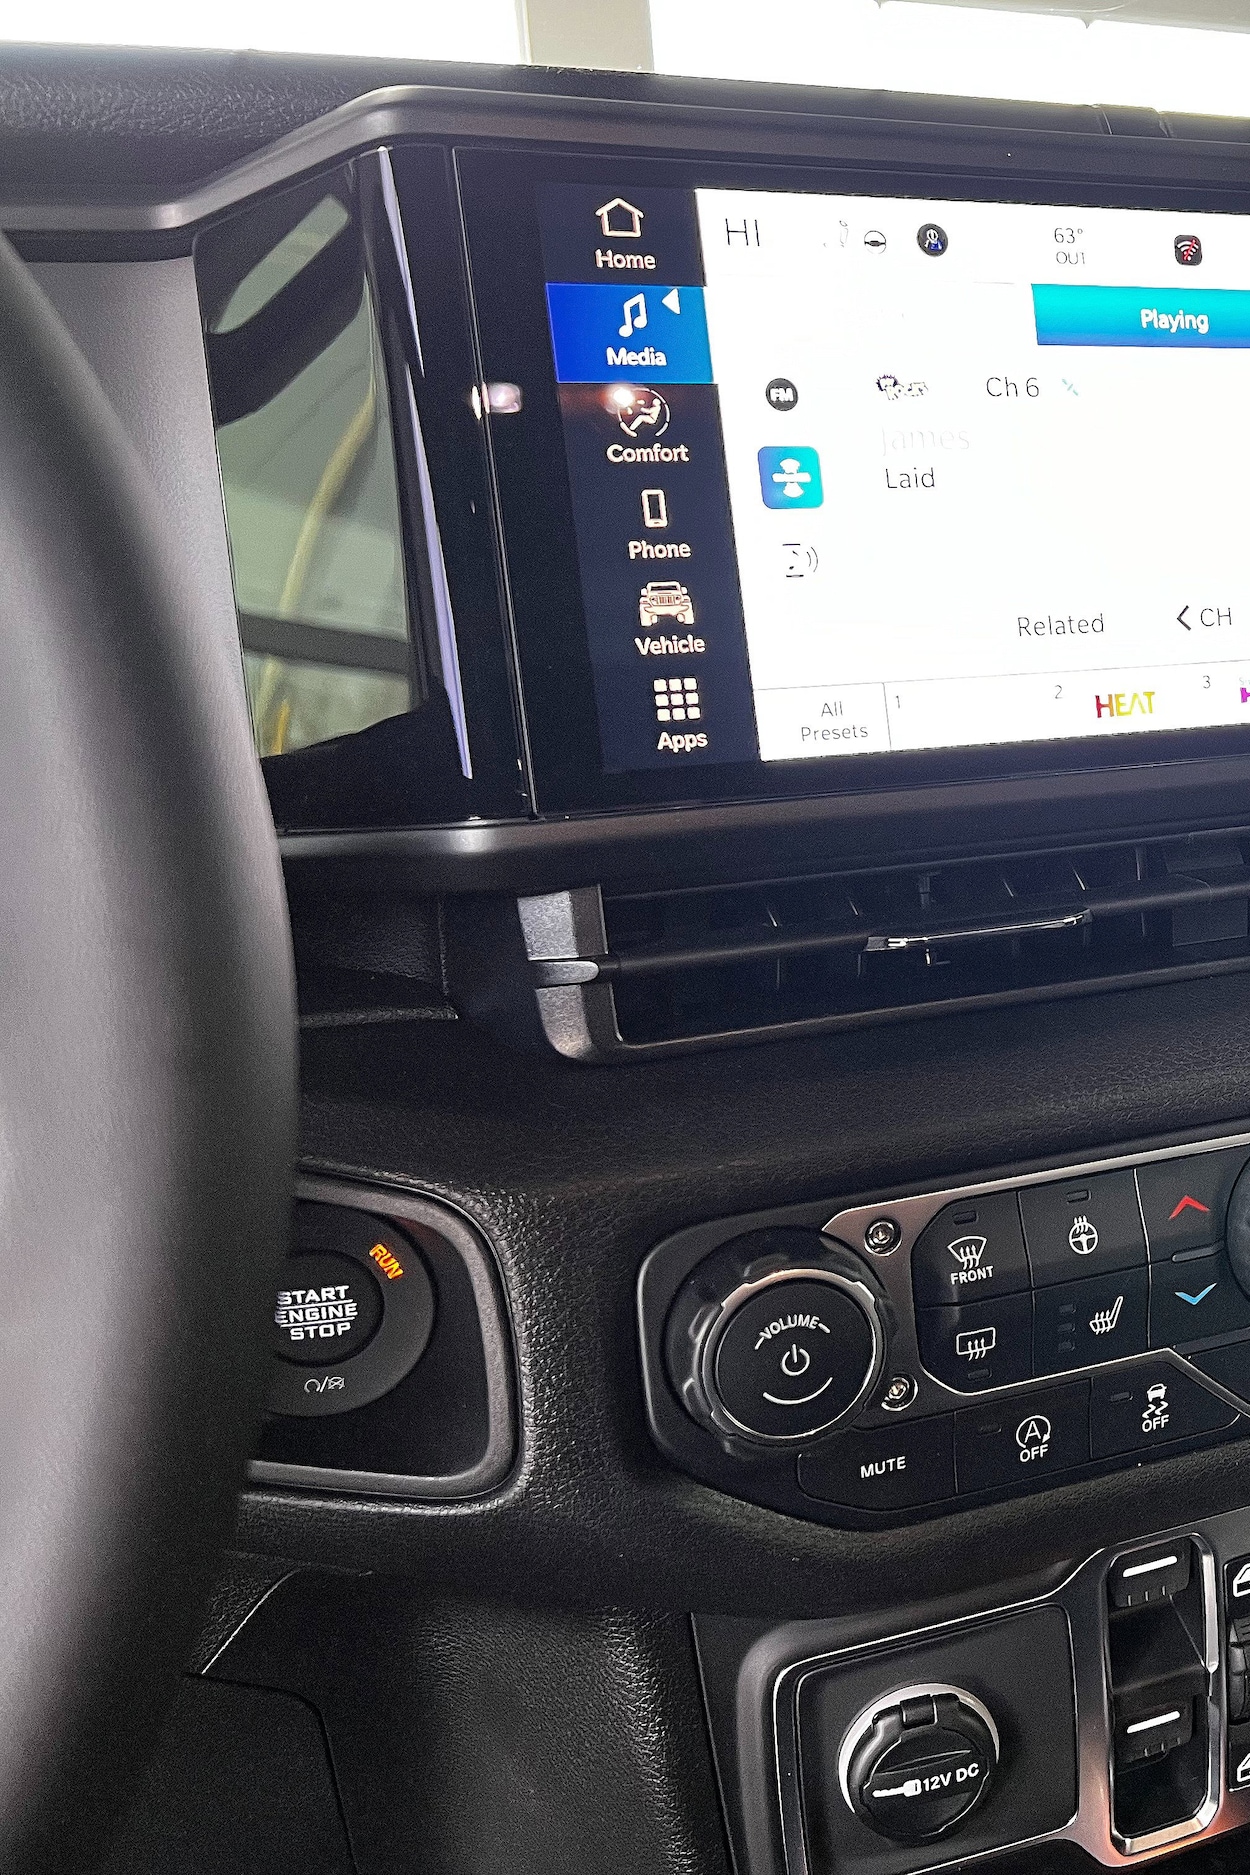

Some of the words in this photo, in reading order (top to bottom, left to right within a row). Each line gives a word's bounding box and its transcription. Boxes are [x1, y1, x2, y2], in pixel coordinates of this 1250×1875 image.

[725, 218, 760, 247] HI
[595, 249, 657, 270] Home
[1140, 308, 1210, 335] Playing
[606, 346, 668, 366] Media
[769, 386, 795, 404] FM
[986, 376, 1019, 398] Ch
[1026, 377, 1040, 398] 6
[606, 443, 690, 463] Comfort
[885, 466, 936, 489] Laid
[628, 540, 692, 560] Phone
[1017, 612, 1105, 637] Related
[1199, 608, 1233, 628] CH
[634, 634, 706, 656] Vehicle
[1054, 684, 1064, 700] 2
[1202, 675, 1212, 689] 3
[820, 700, 844, 718] All
[1094, 690, 1156, 719] HEAT
[657, 731, 709, 753] Apps
[801, 723, 869, 742] Presets
[368, 1242, 404, 1280] RUN
[950, 1265, 994, 1285] FRONT
[276, 1284, 350, 1305] START
[274, 1302, 359, 1324] ENGINE
[289, 1322, 352, 1342] STOP
[759, 1313, 820, 1340] VOLUME
[1141, 1414, 1170, 1433] OFF
[1019, 1443, 1049, 1463] OFF
[860, 1456, 907, 1479] MUTE
[922, 1771, 953, 1792] 12V
[955, 1762, 980, 1783] DC
